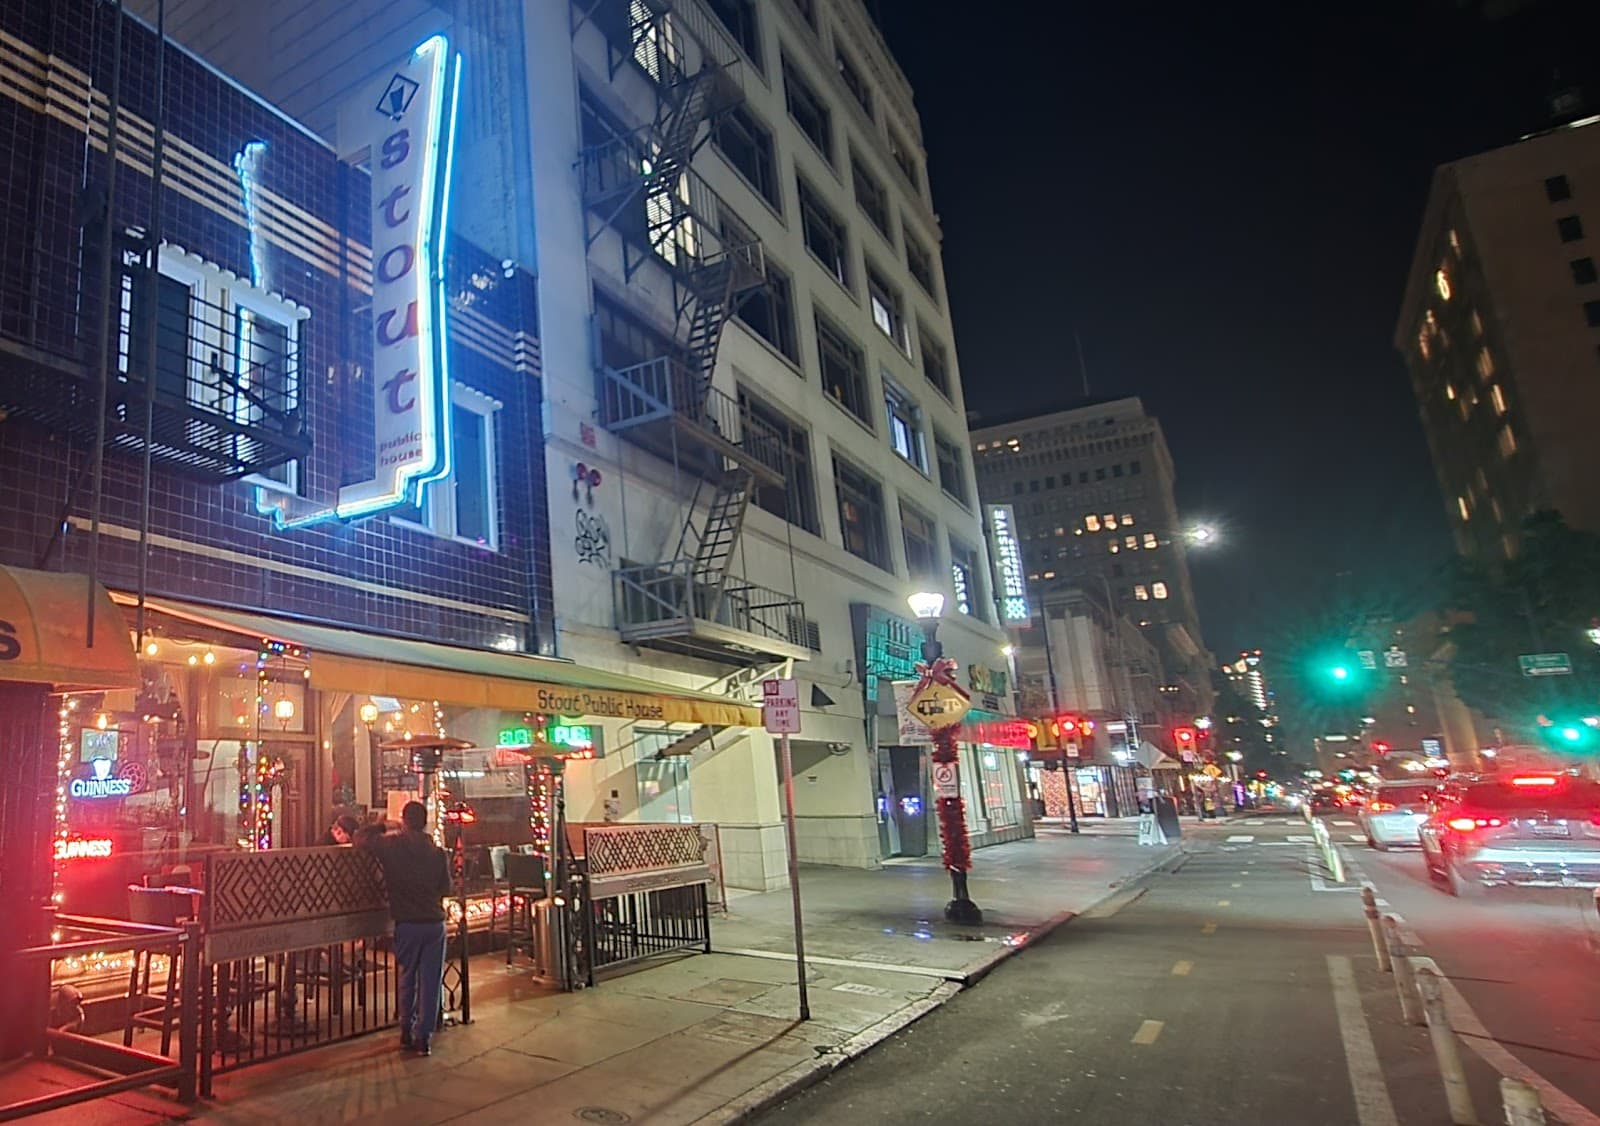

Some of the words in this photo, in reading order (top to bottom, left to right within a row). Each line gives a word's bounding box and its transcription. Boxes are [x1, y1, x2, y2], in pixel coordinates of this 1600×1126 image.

[377, 128, 418, 415] stout
[380, 431, 422, 452] public
[994, 509, 1017, 596] EXPANSIVE
[538, 689, 580, 711] Stout
[584, 693, 623, 716] Public
[625, 699, 664, 719] House
[767, 697, 796, 708] PARKING
[776, 709, 789, 718] ANY
[71, 779, 131, 798] GUINNESS
